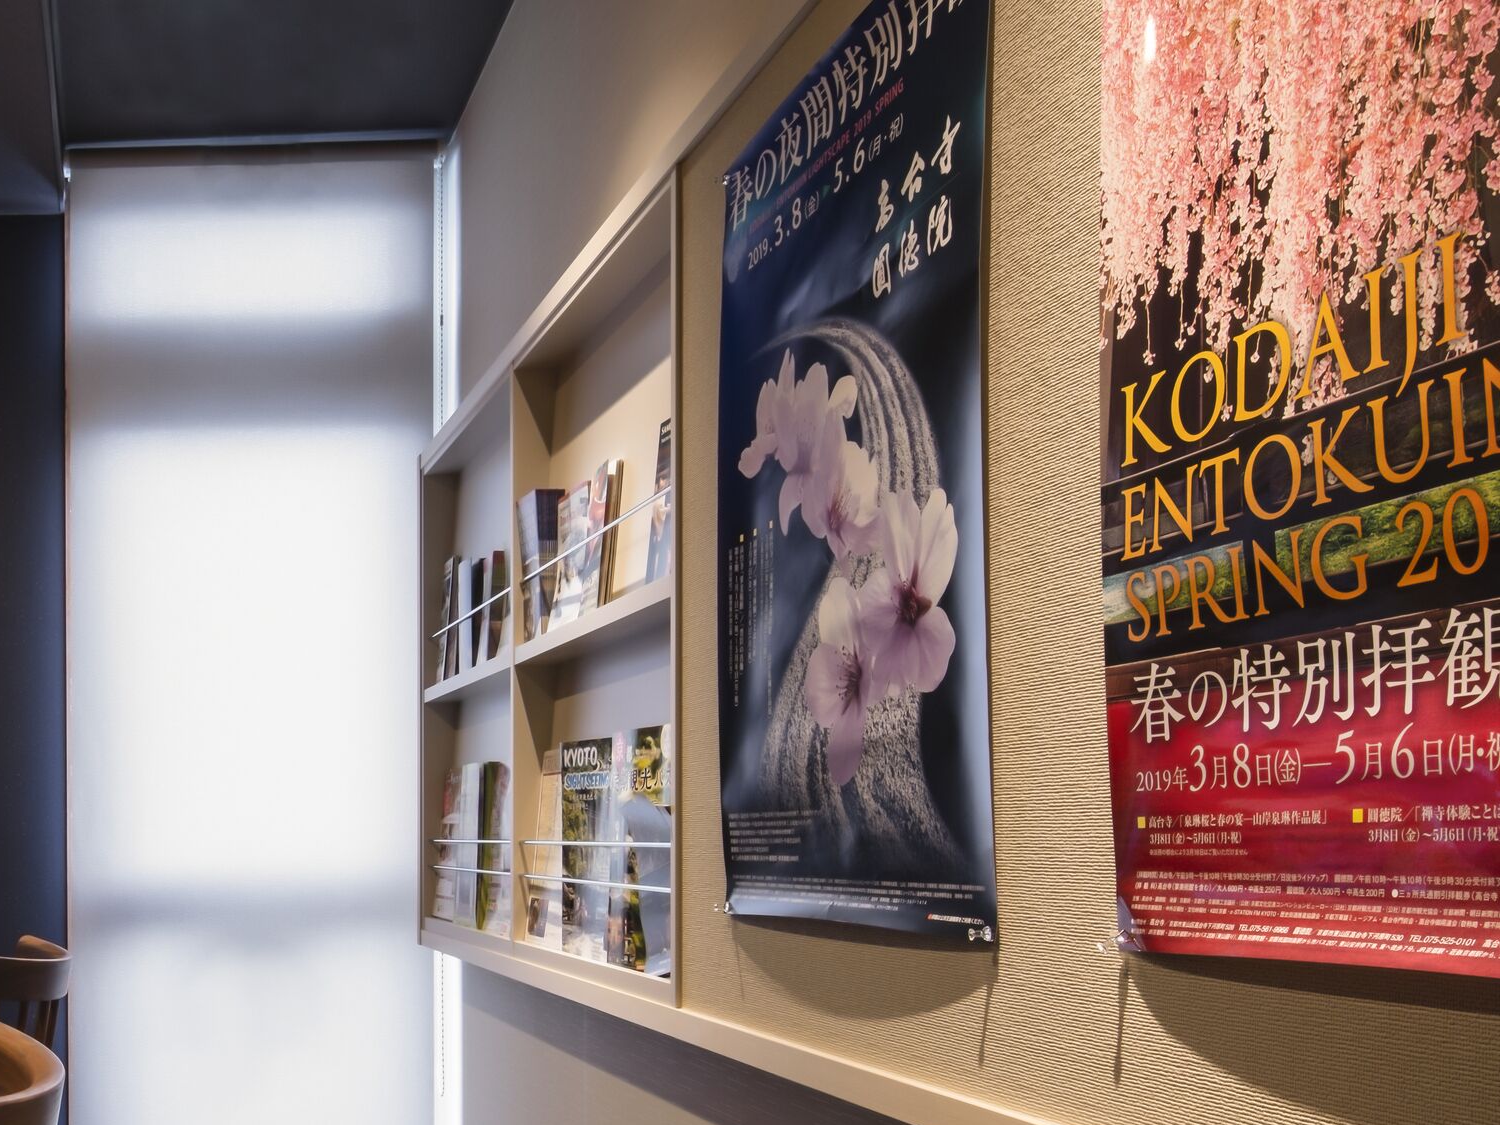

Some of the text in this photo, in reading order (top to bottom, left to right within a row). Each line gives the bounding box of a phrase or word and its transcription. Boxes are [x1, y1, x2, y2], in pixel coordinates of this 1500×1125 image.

[728, 0, 964, 233] 春の夜間特別拝
[852, 107, 873, 138] 2019
[873, 76, 906, 118] SPRING
[1120, 231, 1469, 469] KODAIJI
[1125, 514, 1370, 643] SPRING
[1129, 606, 1500, 744] 春の特別拝観
[563, 746, 598, 768] KYOTO
